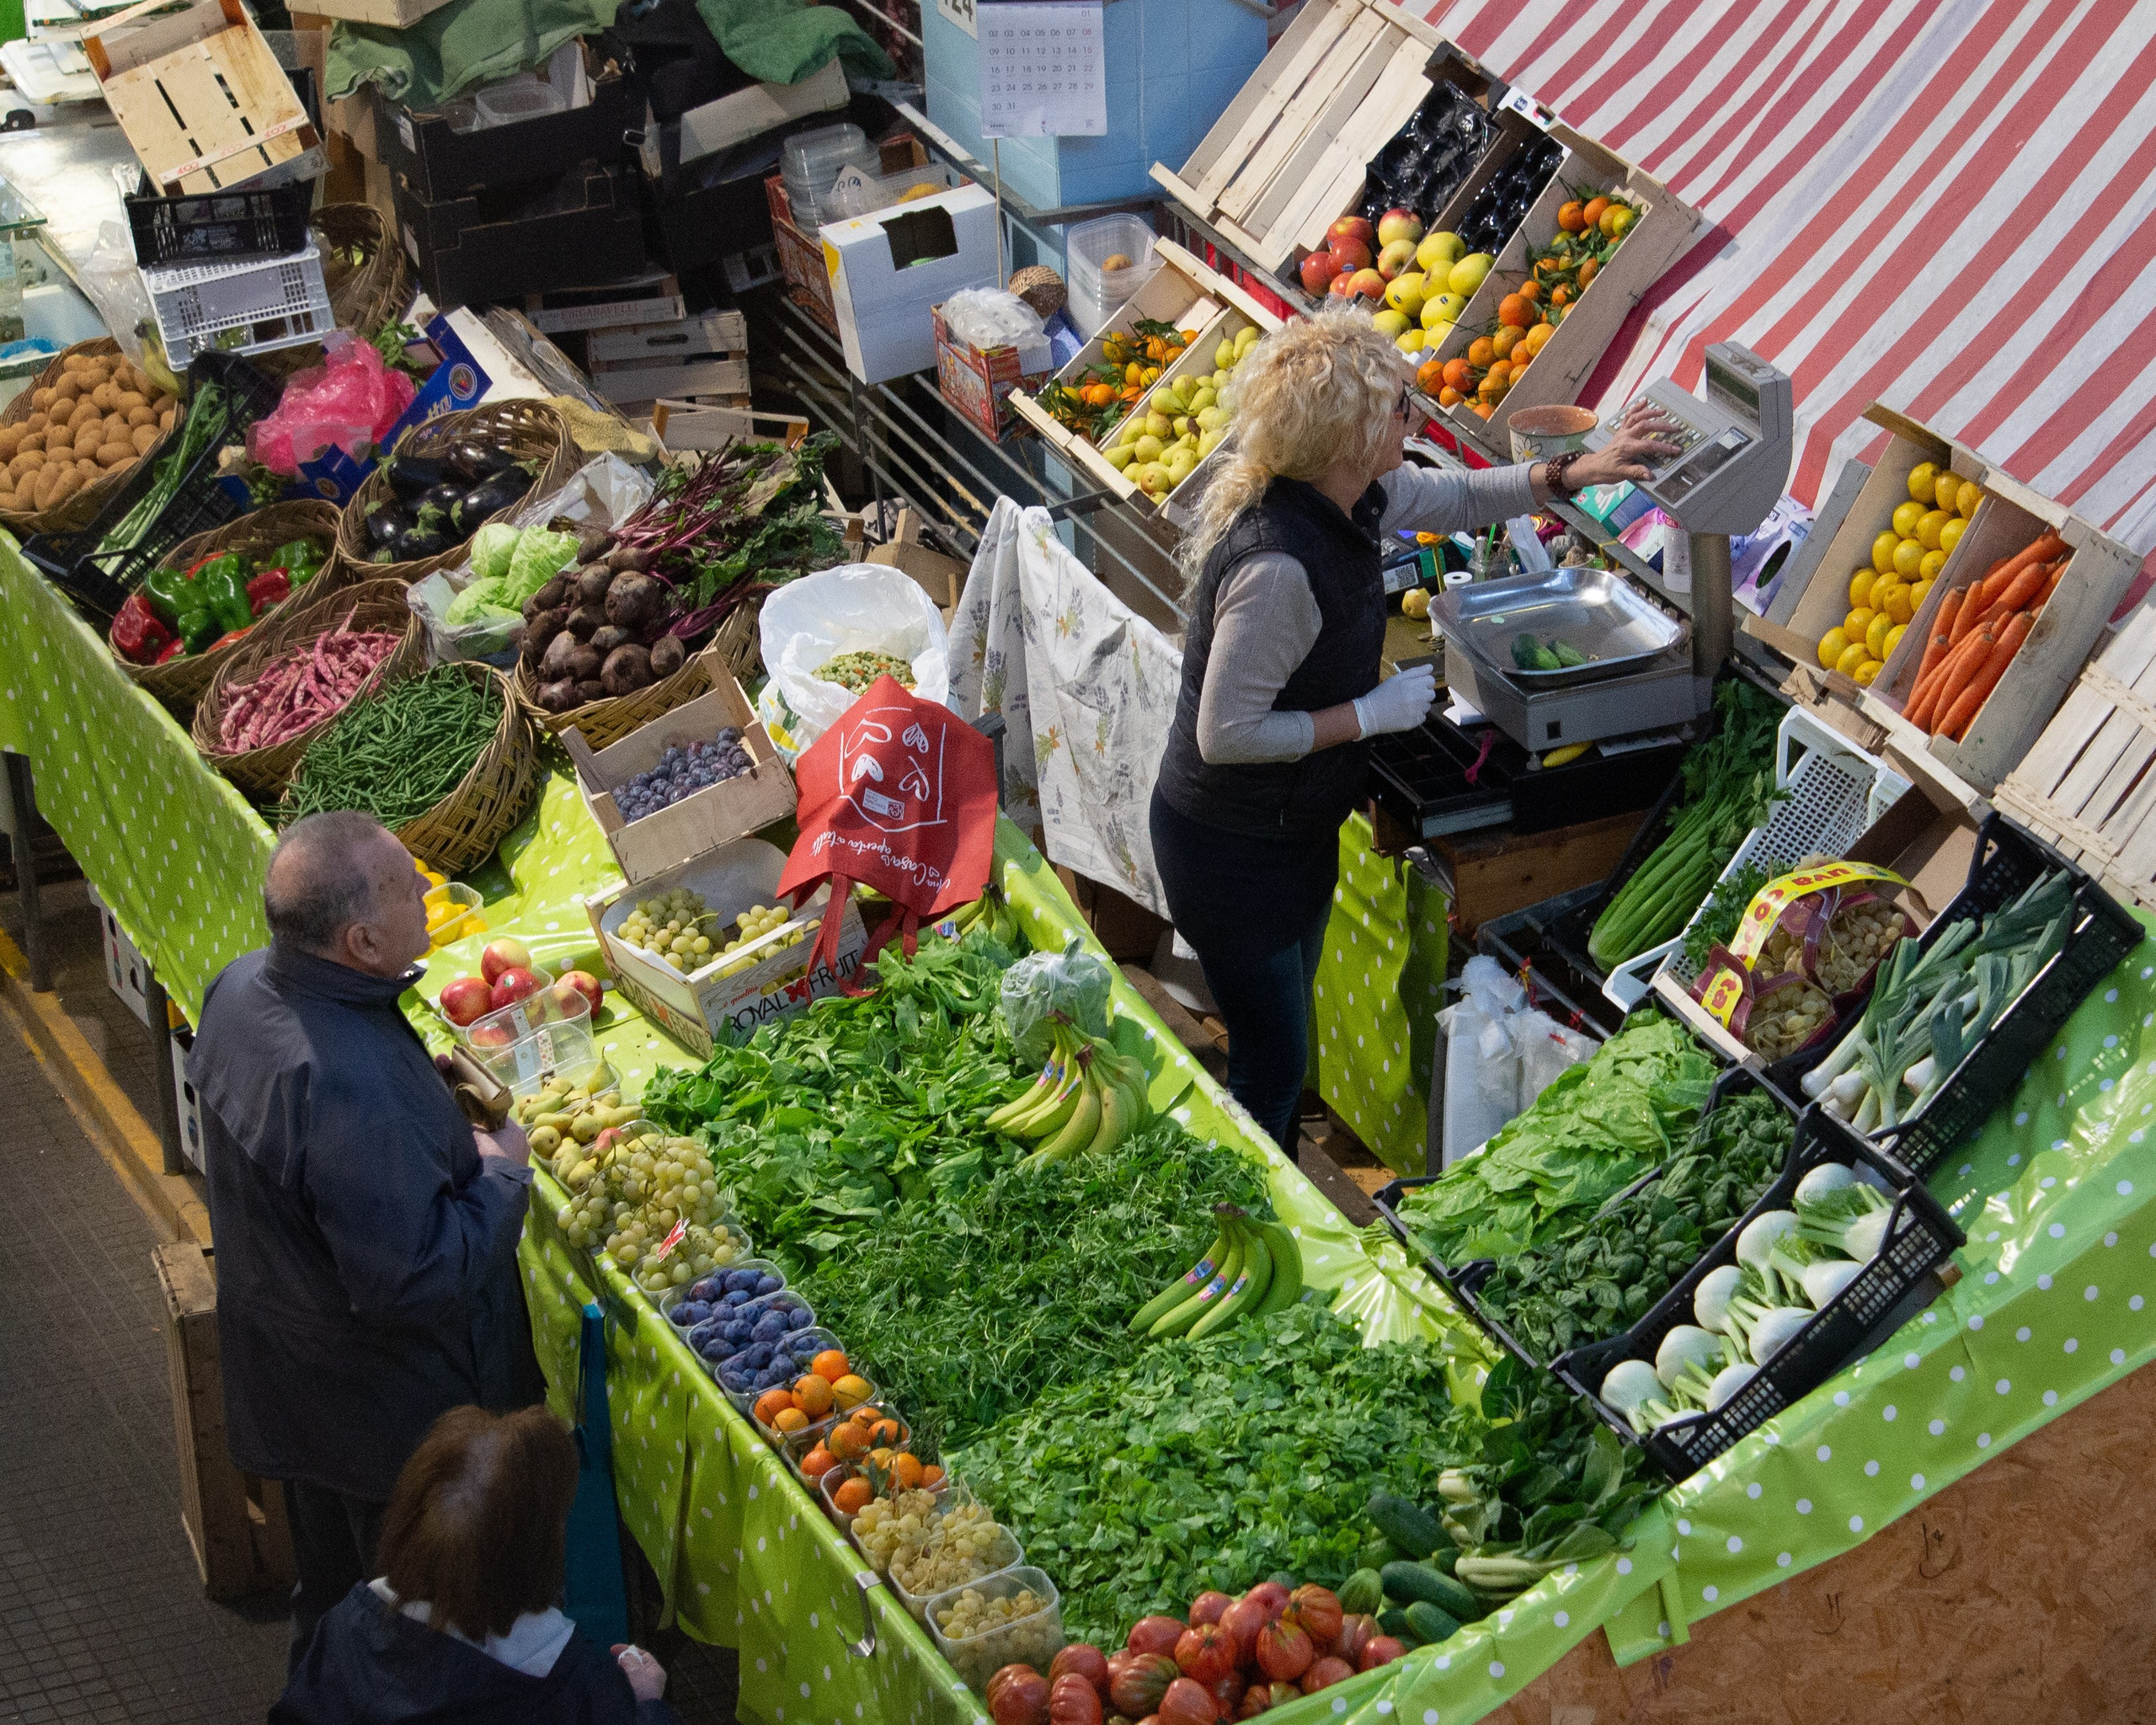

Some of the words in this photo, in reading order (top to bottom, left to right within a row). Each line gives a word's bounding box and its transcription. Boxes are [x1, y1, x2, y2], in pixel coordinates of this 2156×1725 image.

[988, 29, 999, 38] 02
[1004, 29, 1014, 38] 03
[1020, 29, 1031, 37] 04
[1034, 29, 1045, 37] 05
[1049, 29, 1060, 37] 06
[989, 47, 1000, 56] 09
[1006, 47, 1015, 56] 10
[1067, 46, 1077, 55] 14
[990, 66, 1001, 74] 16
[1037, 65, 1047, 73] 19
[990, 84, 1001, 93] 23
[1022, 83, 1033, 92] 25
[1037, 83, 1048, 92] 26
[991, 103, 1002, 111] 30
[848, 837, 892, 856] aperta
[889, 854, 927, 885] Casa
[1791, 868, 1851, 885] uva
[729, 993, 789, 1033] ROYAL
